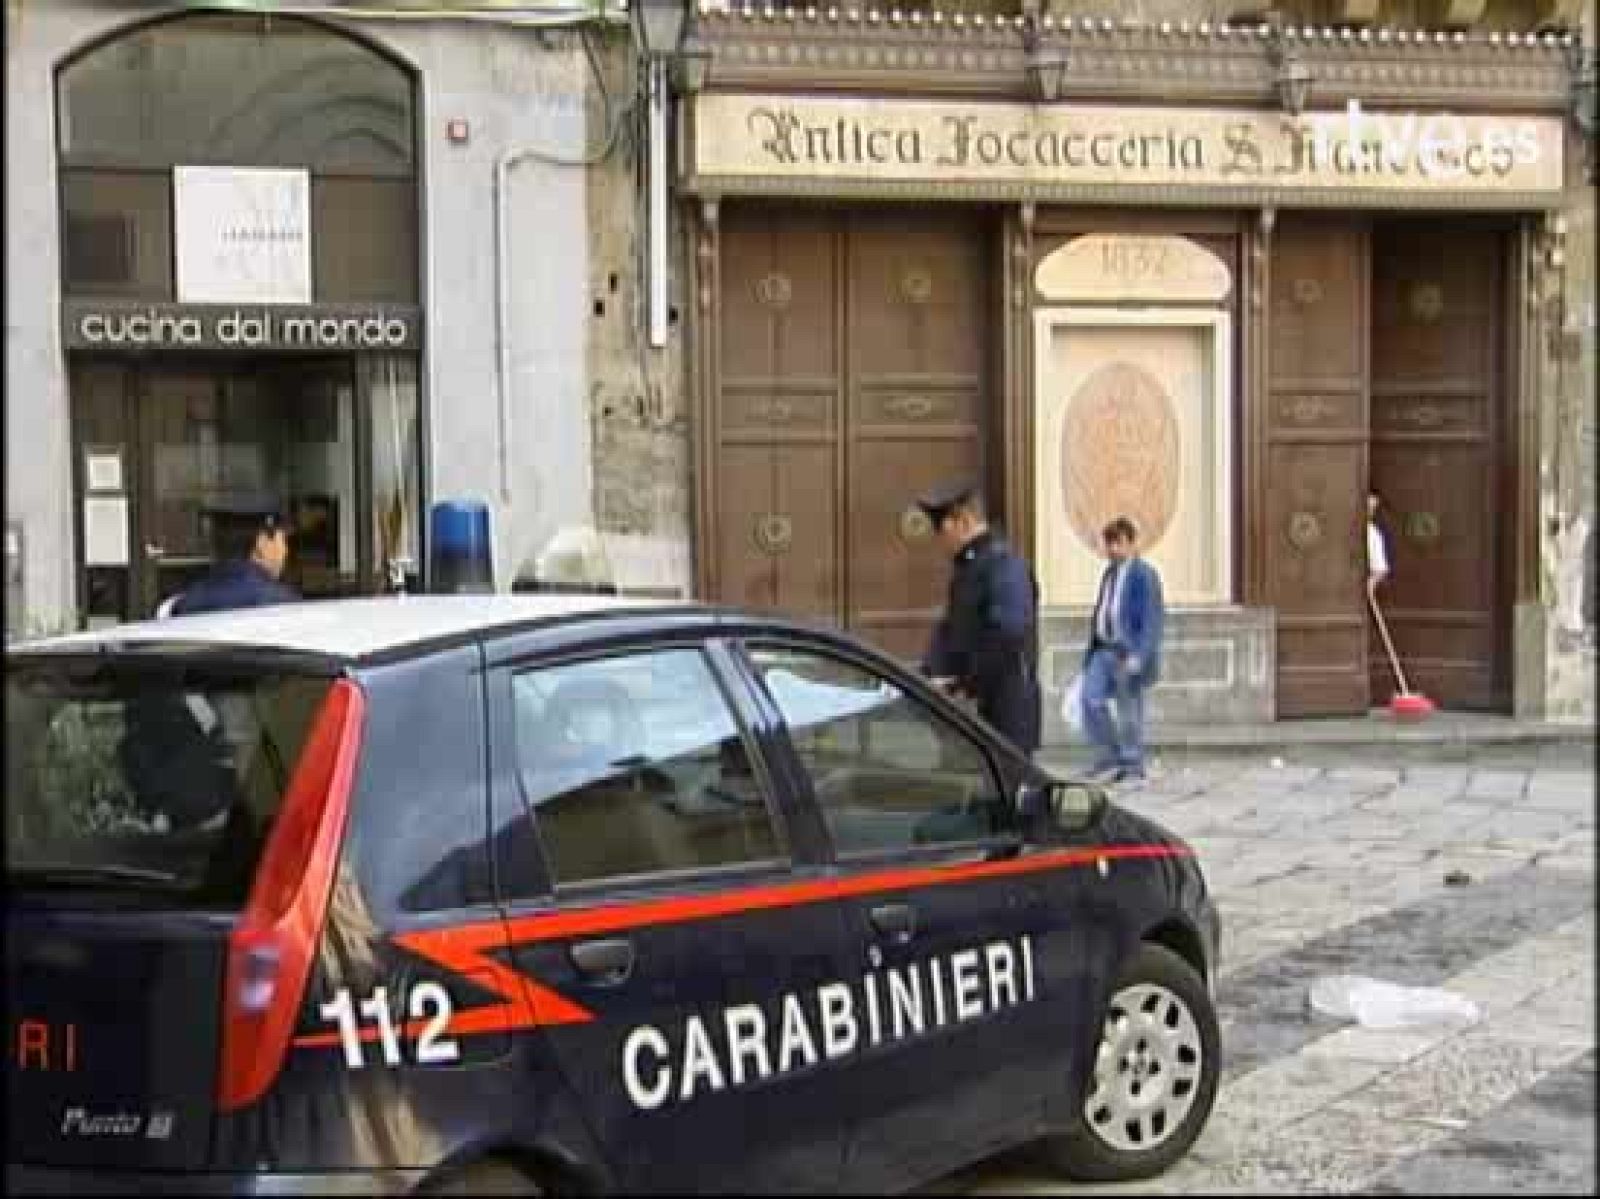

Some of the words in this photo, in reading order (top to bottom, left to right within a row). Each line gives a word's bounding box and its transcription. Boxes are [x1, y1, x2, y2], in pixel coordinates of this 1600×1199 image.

[747, 109, 922, 164] Antica
[937, 114, 1204, 171] Focacceria
[1274, 122, 1515, 177] Franco
[80, 308, 203, 344] cucina
[216, 310, 272, 344] dal
[283, 311, 408, 348] mondo
[319, 982, 460, 1070] 112
[622, 935, 1037, 1110] CARABINIERI
